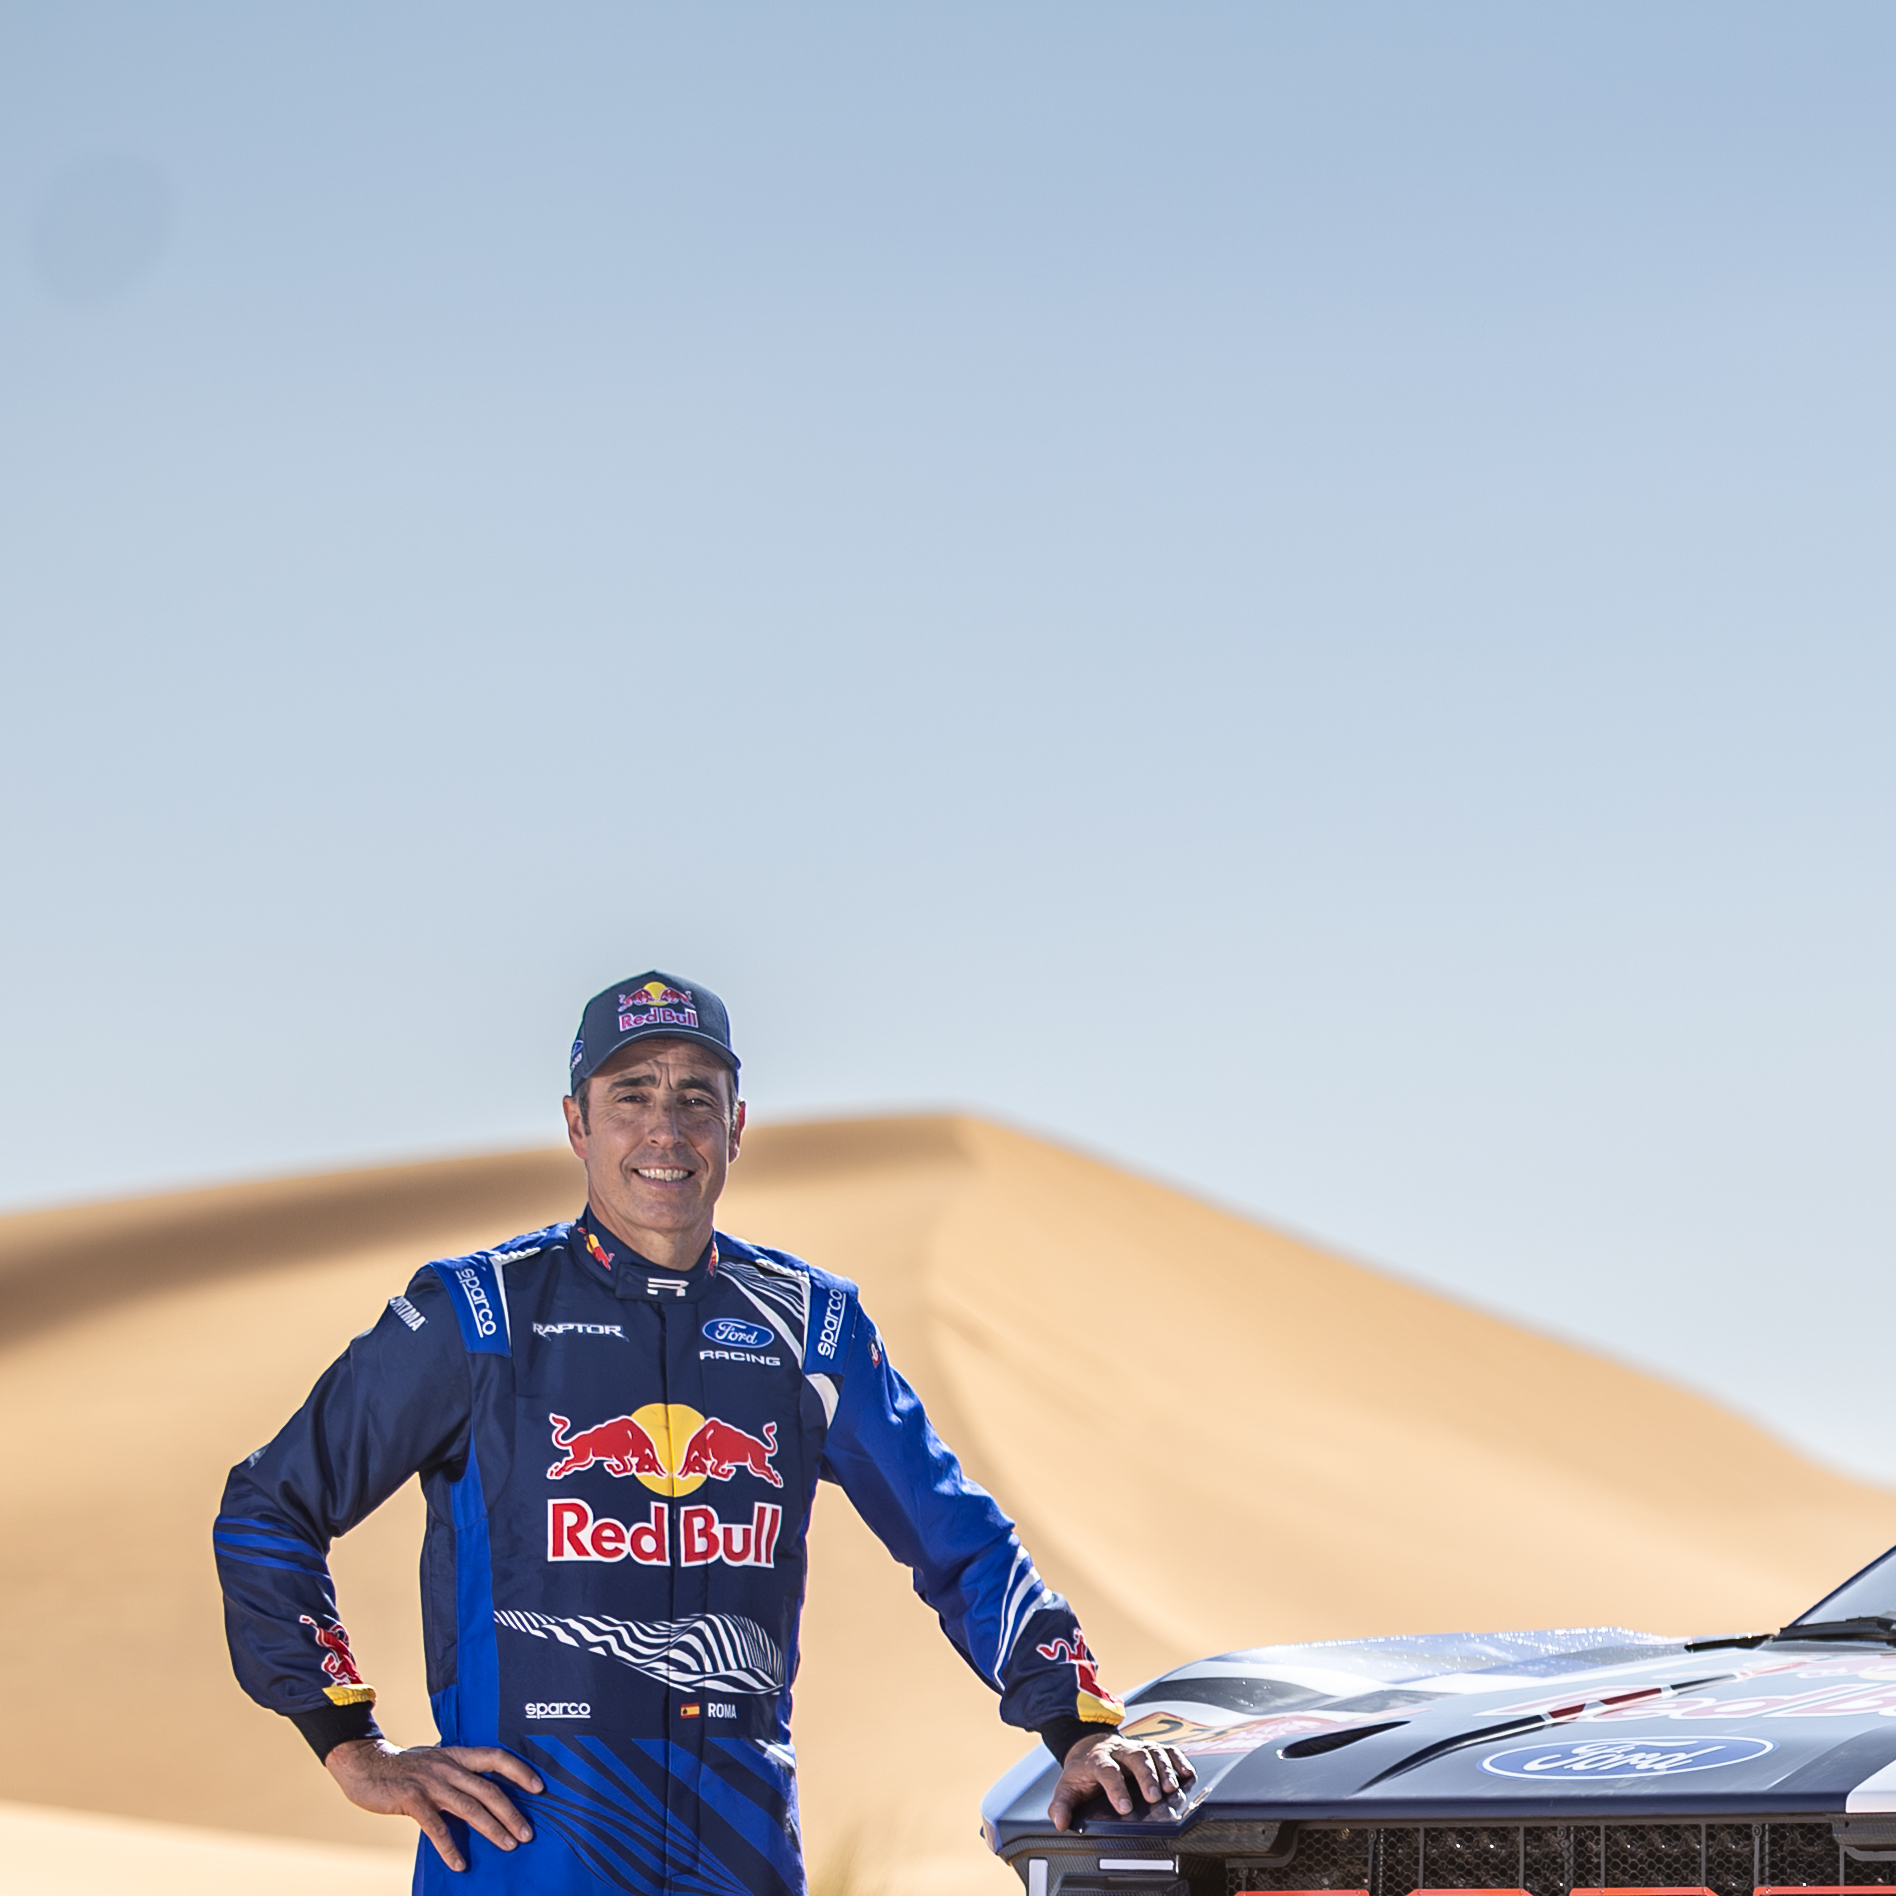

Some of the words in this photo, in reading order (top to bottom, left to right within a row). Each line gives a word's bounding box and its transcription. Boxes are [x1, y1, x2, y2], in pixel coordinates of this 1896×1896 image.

[620, 1007, 660, 1031] Red
[661, 1007, 699, 1028] Bull
[456, 1268, 497, 1339] sparco
[532, 1321, 630, 1342] RAPTOR
[714, 1321, 758, 1346] Ford
[817, 1289, 847, 1360] sparco
[700, 1350, 781, 1366] RACING
[548, 1499, 671, 1566] Red
[680, 1502, 782, 1568] Bull
[525, 1703, 591, 1719] sparco
[708, 1703, 737, 1719] ROMA
[1522, 1739, 1727, 1773] Ford
